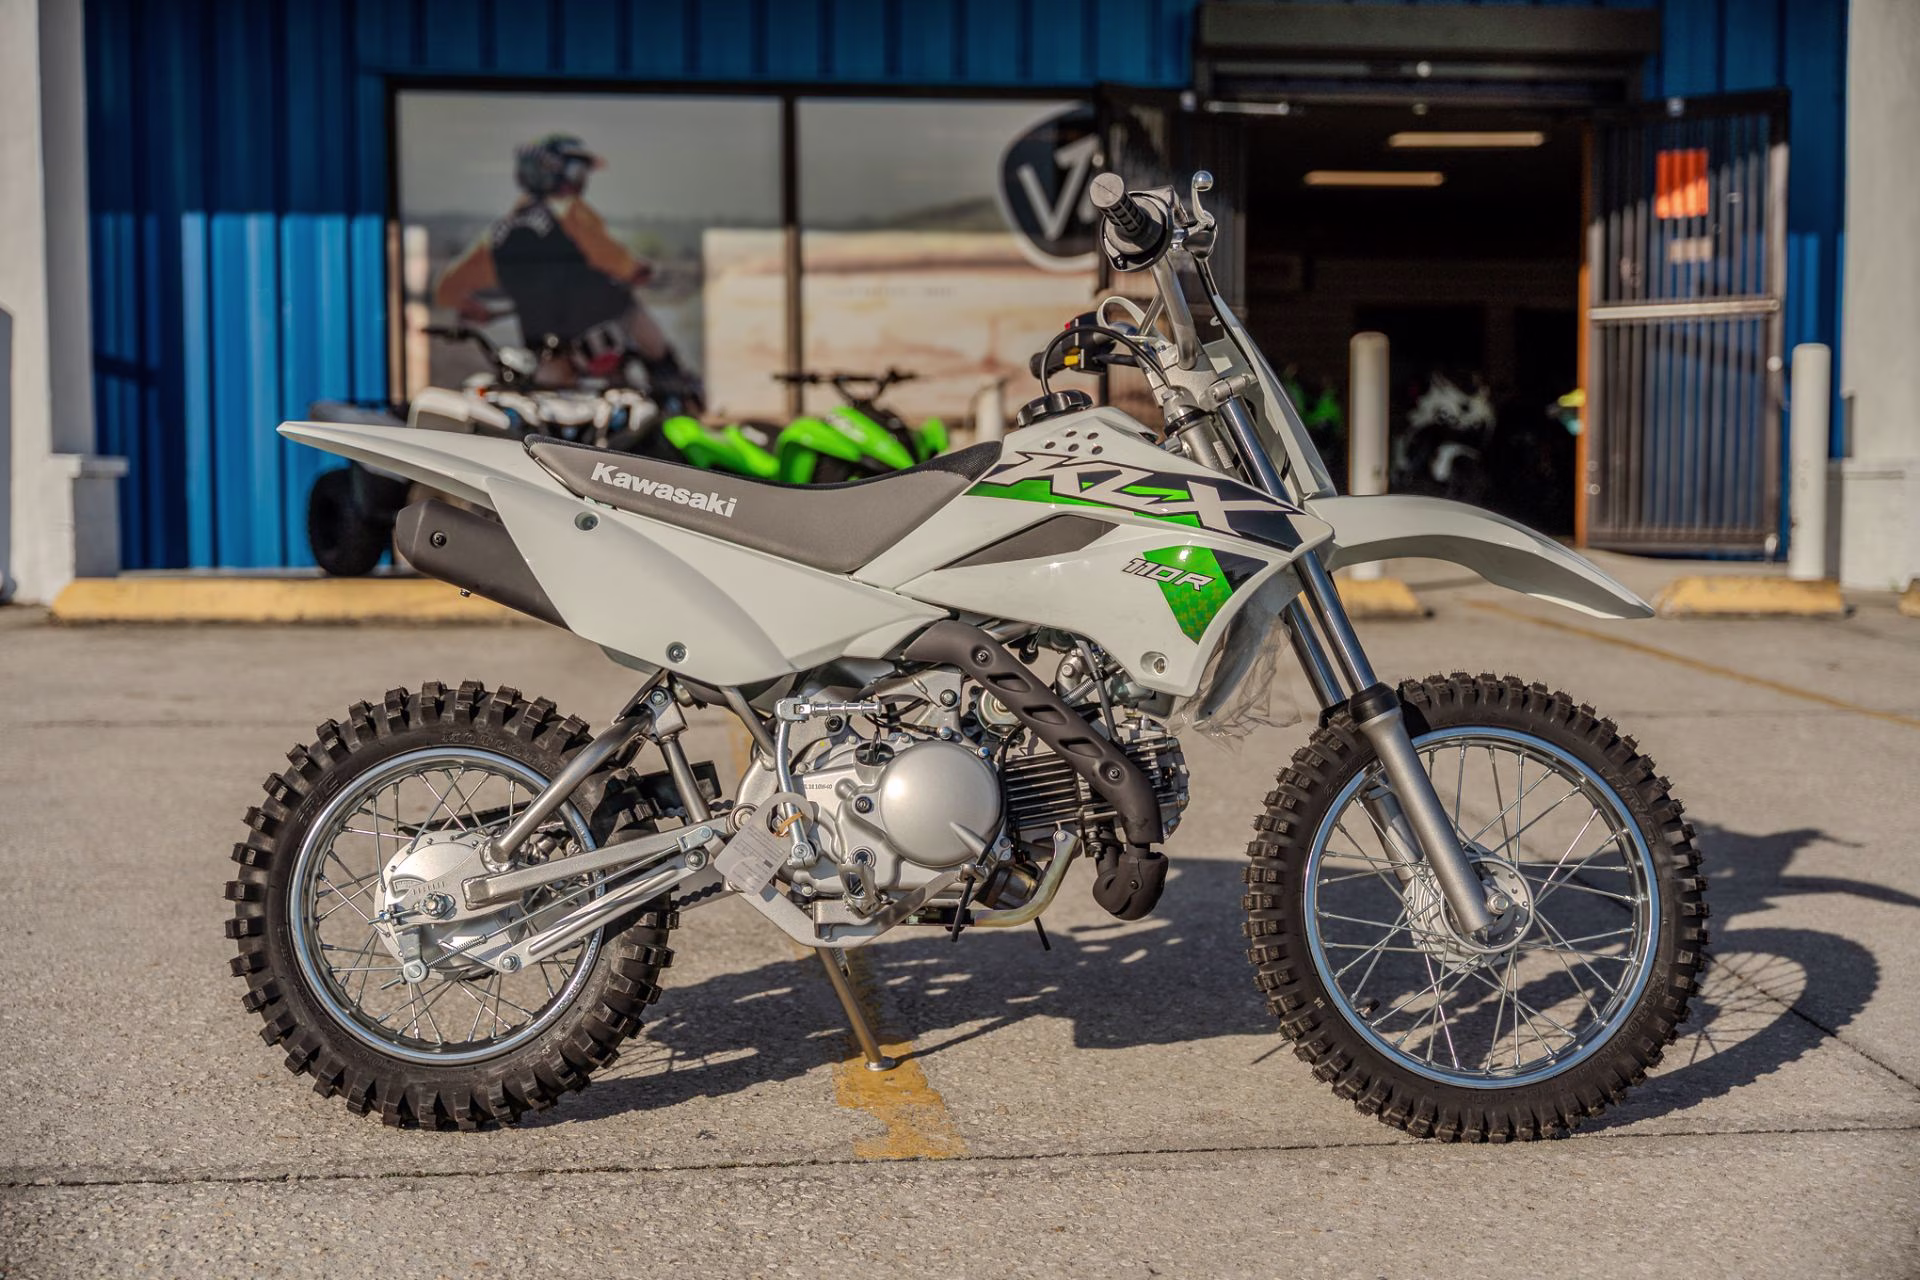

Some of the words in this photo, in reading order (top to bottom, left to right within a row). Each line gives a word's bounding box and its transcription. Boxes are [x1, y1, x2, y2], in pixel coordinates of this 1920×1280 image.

[590, 461, 738, 518] Kawasaki
[981, 452, 1303, 536] KLX
[1122, 558, 1216, 592] 110R
